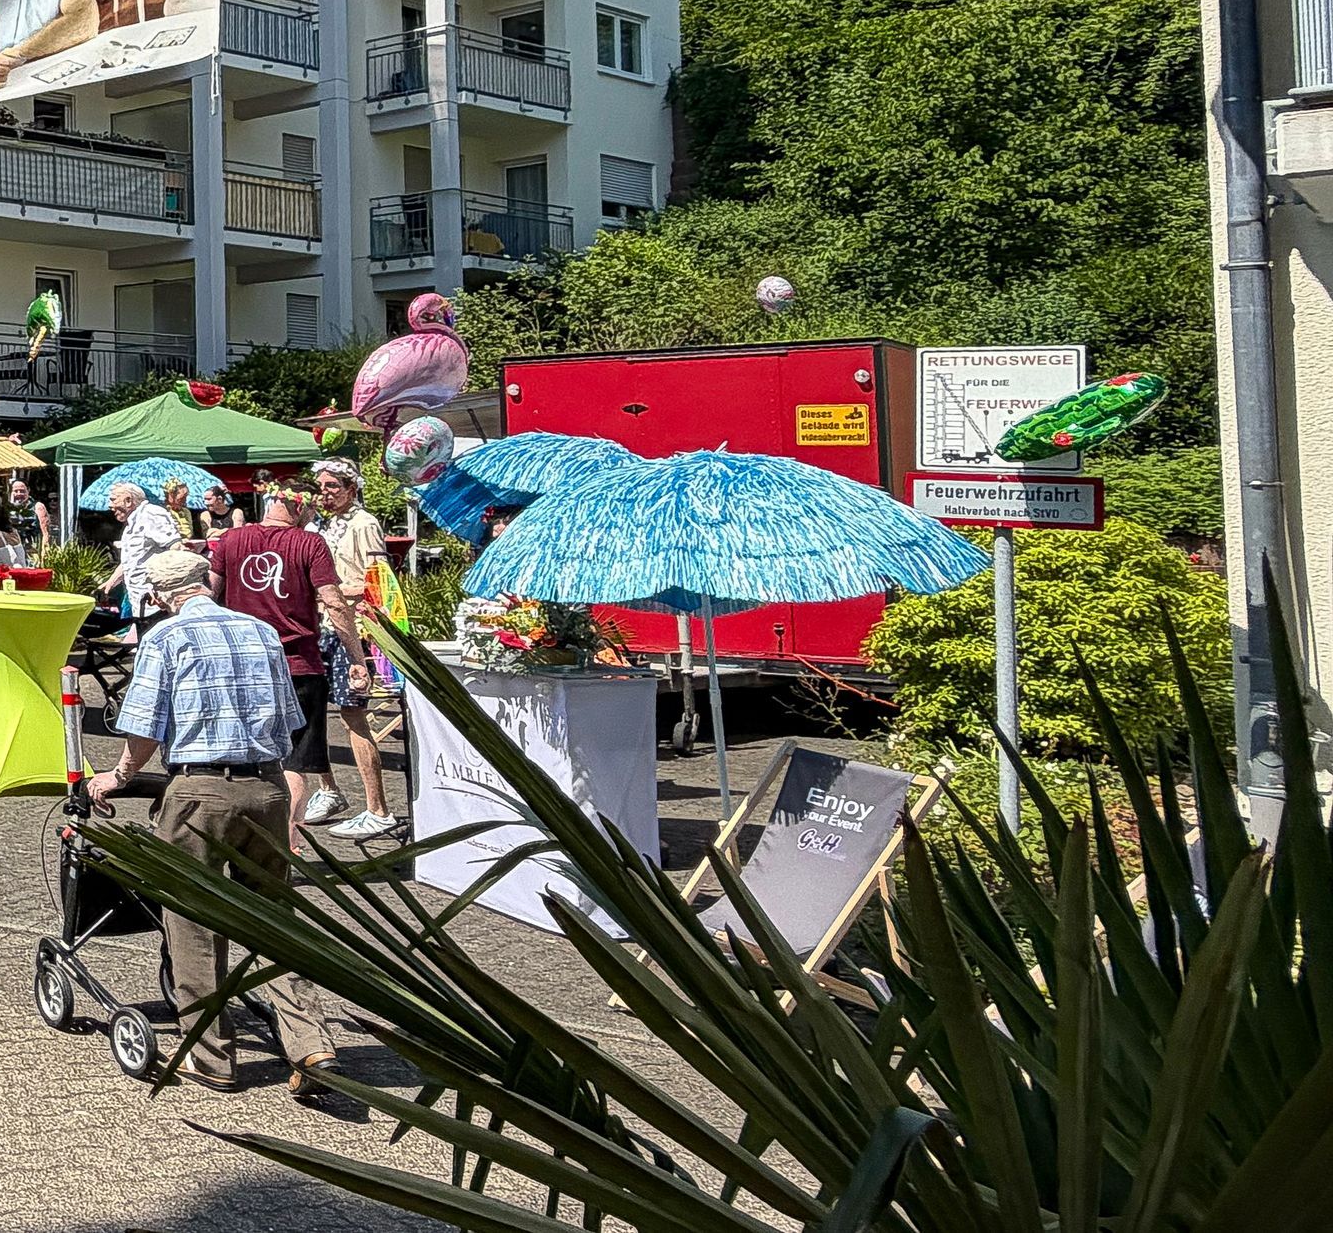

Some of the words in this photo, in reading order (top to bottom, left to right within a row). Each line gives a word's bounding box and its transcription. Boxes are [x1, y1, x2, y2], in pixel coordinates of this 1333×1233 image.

[927, 354, 1074, 367] RETTUNGSWEGE
[966, 378, 989, 387] FÜR
[991, 379, 1010, 387] DIE
[966, 399, 1053, 409] FEUERWE
[801, 410, 833, 418] Dieses
[801, 422, 840, 430] Gelände
[843, 422, 865, 430] wird
[925, 483, 1081, 503] Feuerwehrzufahrt
[944, 505, 1001, 517] Haltverbot
[1004, 508, 1030, 517] nach
[806, 787, 875, 821] Enjoy
